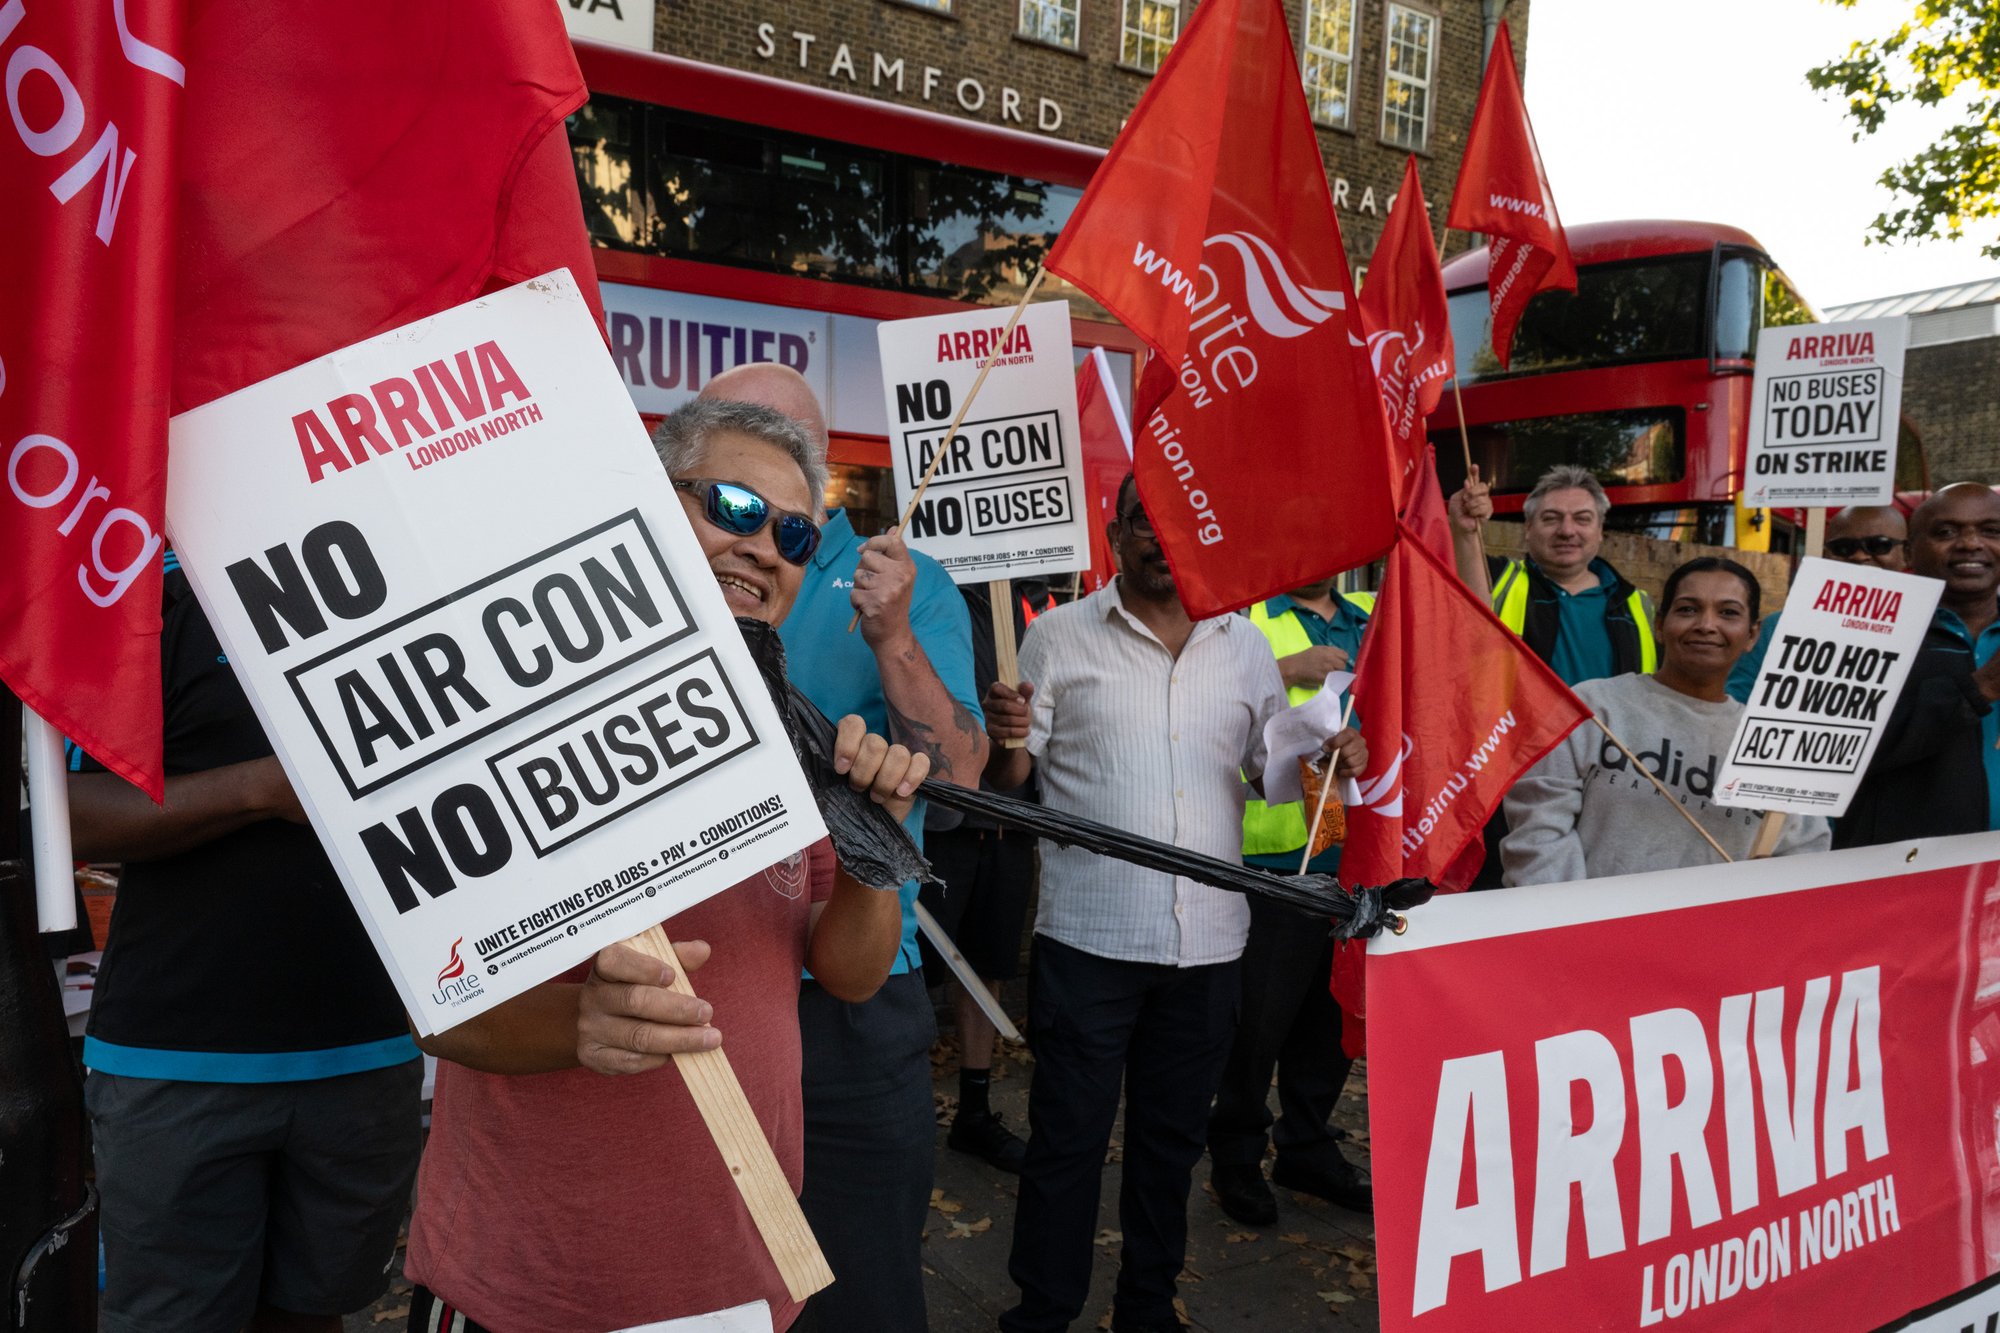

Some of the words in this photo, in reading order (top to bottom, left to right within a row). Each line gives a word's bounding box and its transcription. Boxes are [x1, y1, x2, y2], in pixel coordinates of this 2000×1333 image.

[756, 22, 1064, 132] STAMFORD
[937, 324, 1033, 363] ARRIVA
[976, 358, 1007, 369] LODON
[1008, 355, 1034, 366] NORTH
[1786, 331, 1875, 361] ARRIVA
[896, 379, 952, 424] NO
[1181, 353, 1213, 410] ION
[1773, 380, 1801, 403] NO
[1808, 373, 1877, 400] BUSES
[291, 340, 532, 484] ARRIVA
[405, 427, 482, 471] LONDON
[480, 403, 543, 441] NORTH
[1771, 400, 1876, 439] TODAY
[919, 435, 973, 479] AIR
[981, 422, 1053, 469] CON
[1148, 406, 1224, 546] nion.org
[1755, 453, 1789, 475] ON
[1794, 450, 1888, 475] STRIKE
[908, 496, 964, 539] NO
[975, 486, 1064, 528] BUSES
[954, 555, 982, 564] FIGHTING
[983, 554, 995, 562] FOR
[996, 552, 1011, 560] JOBS
[225, 520, 387, 655] NO
[1812, 578, 1903, 623] ARRIVA
[1841, 618, 1870, 632] LONDON
[1869, 622, 1894, 635] NORTH
[334, 632, 491, 768] AIR
[481, 542, 663, 688] CON
[1778, 634, 1837, 676] TOO
[1835, 645, 1900, 685] HOT
[1759, 672, 1799, 710] TO
[1799, 678, 1888, 722] WORK
[1741, 726, 1795, 762] ACT
[1792, 730, 1862, 766] NOW!
[358, 783, 513, 915] NO
[516, 677, 731, 831] BUSES
[474, 924, 520, 956] UNITE
[518, 892, 586, 936] FIGHTING
[584, 878, 615, 903] FOR
[615, 861, 649, 889] JOBS
[660, 841, 687, 866] PAY
[699, 794, 784, 846] CONDITIONS!
[500, 932, 565, 968] @unitetheunion
[656, 856, 718, 890] @unitetheunion
[432, 973, 481, 1006] unite
[1412, 964, 1890, 1318] ARRIVA
[1639, 1216, 1792, 1328] LONDON
[1800, 1174, 1901, 1270] NORTH
